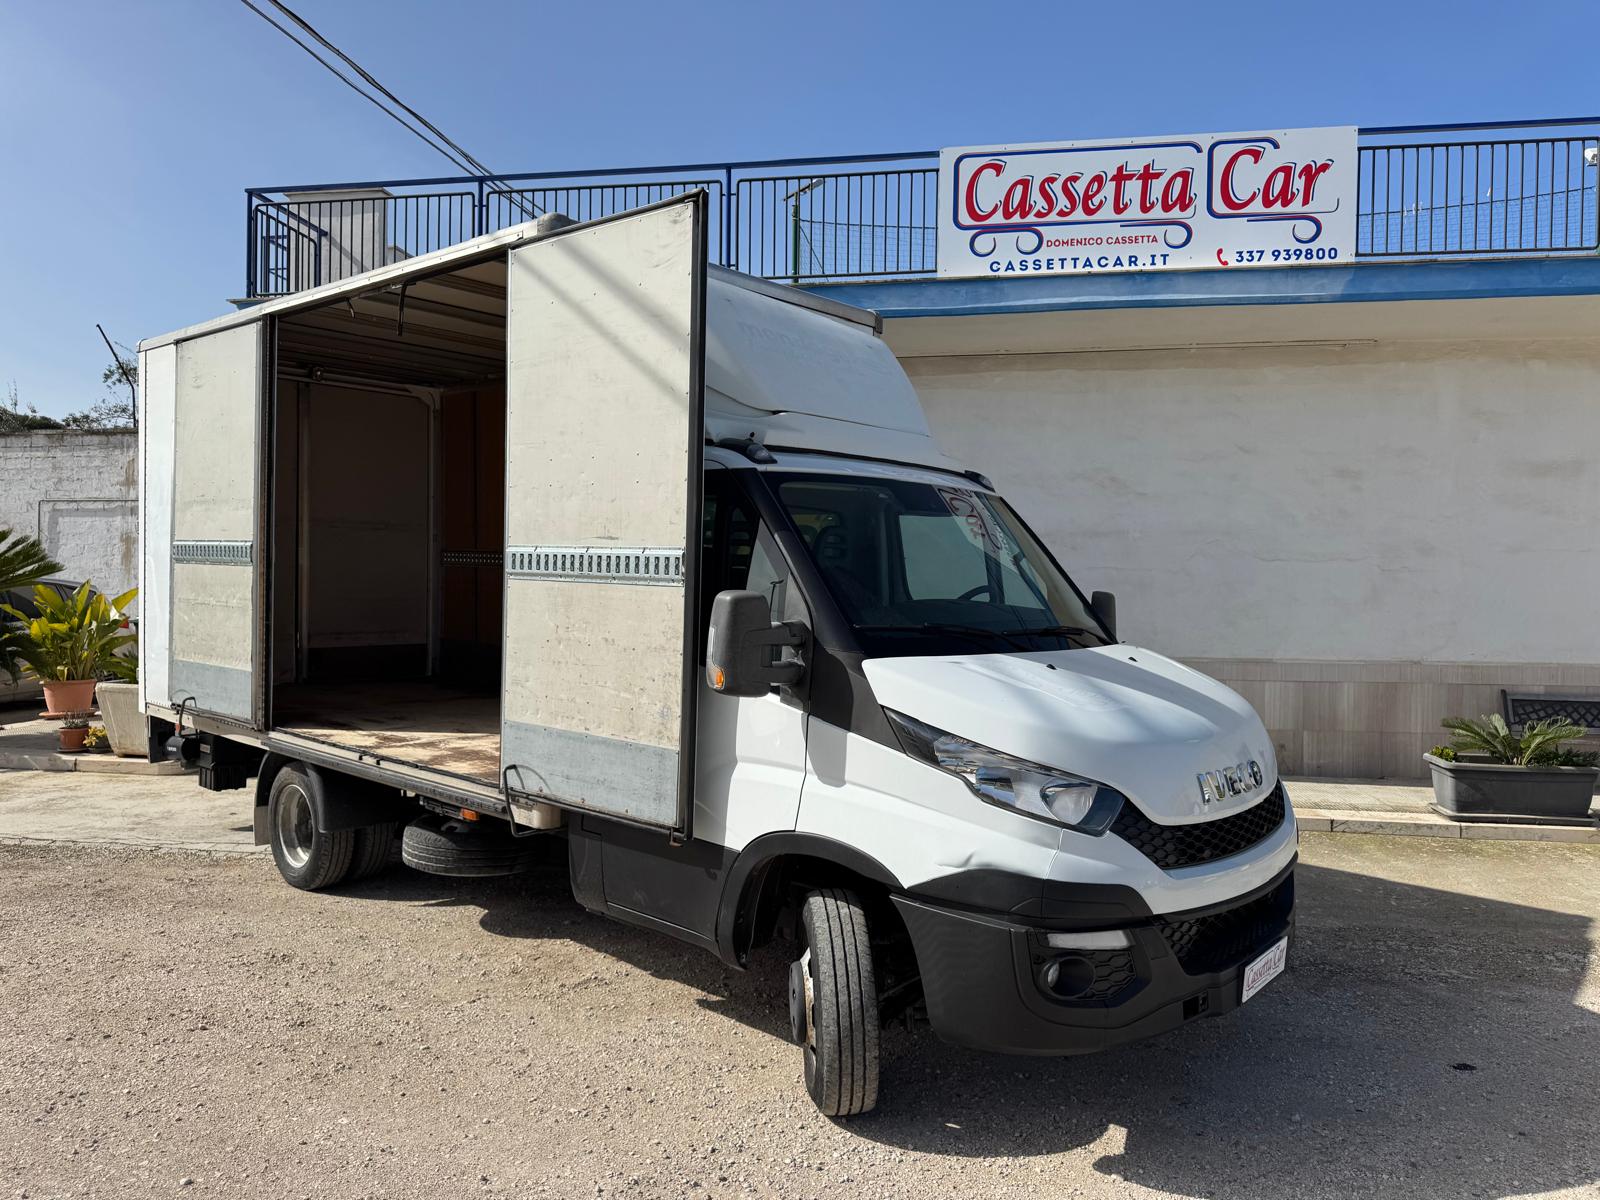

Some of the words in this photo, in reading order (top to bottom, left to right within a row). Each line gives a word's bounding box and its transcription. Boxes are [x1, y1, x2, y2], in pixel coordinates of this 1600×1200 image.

[964, 158, 1199, 223] Cassetta
[1219, 145, 1336, 213] Car
[1046, 236, 1103, 249] DOMENICO
[1105, 234, 1158, 246] CASSETTA
[989, 253, 1170, 273] CASSETTACAR.IT
[1235, 249, 1266, 263] 337
[1271, 247, 1338, 262] 939800
[1196, 760, 1263, 805] IVECO
